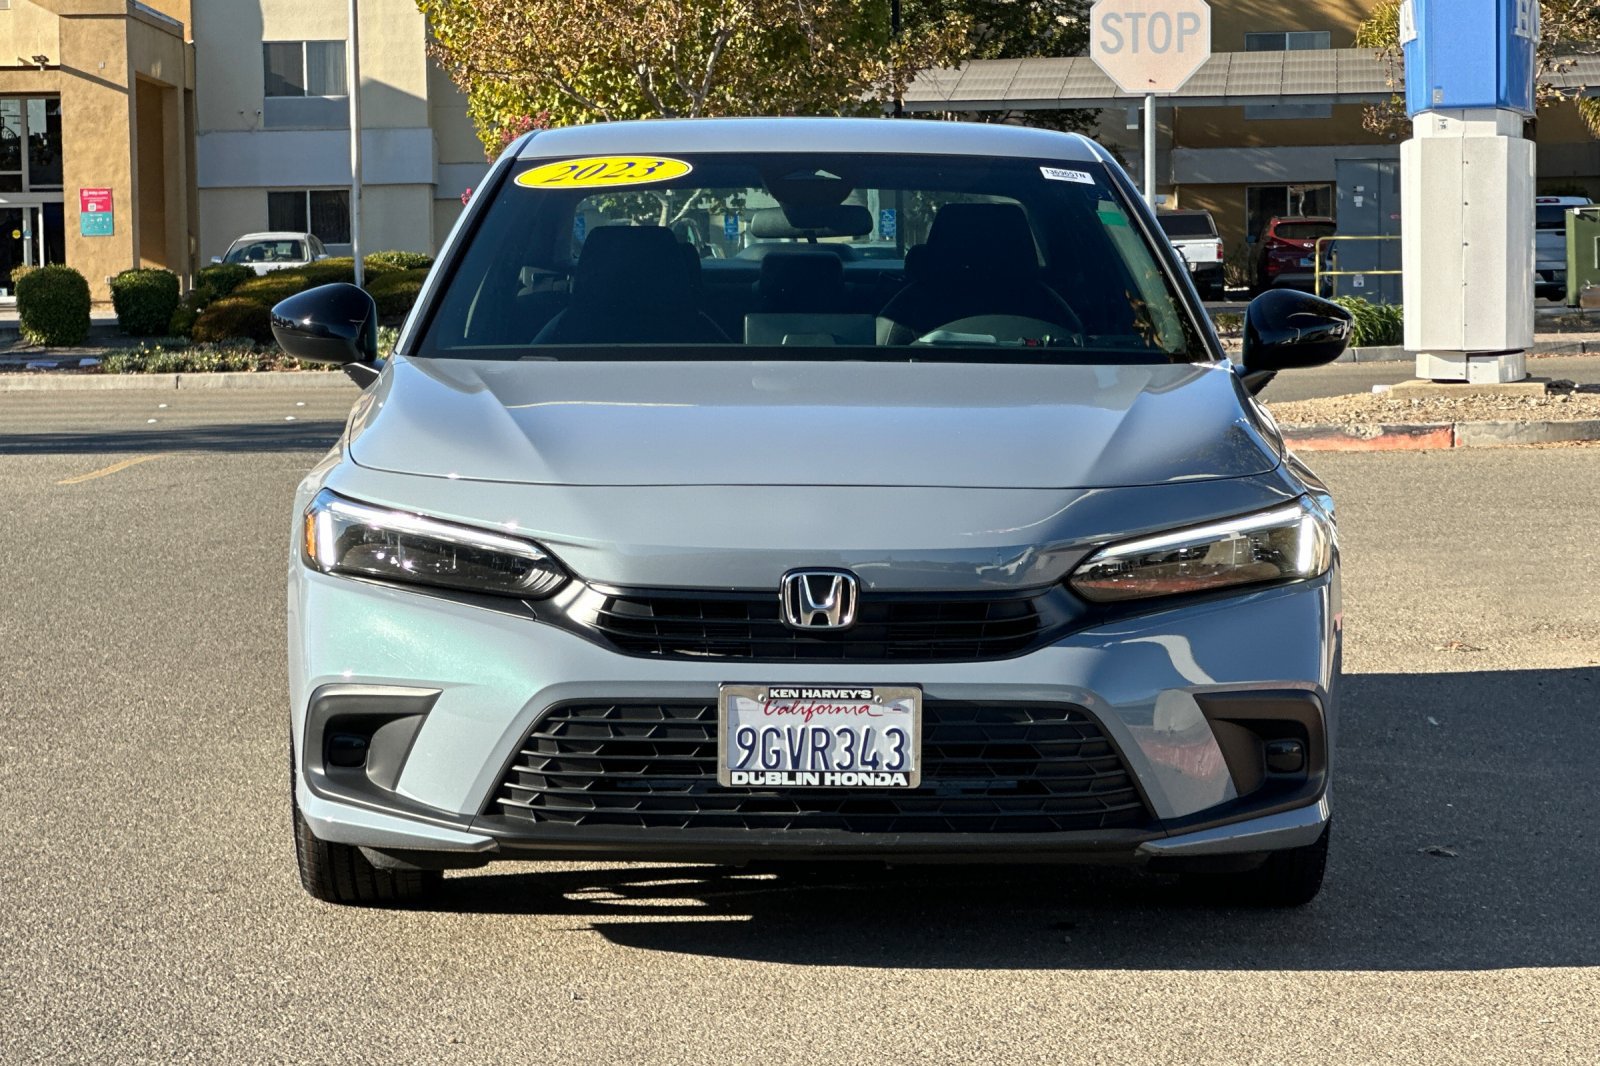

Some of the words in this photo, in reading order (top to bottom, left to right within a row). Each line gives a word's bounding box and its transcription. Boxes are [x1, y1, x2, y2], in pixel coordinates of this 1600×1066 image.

[1100, 11, 1201, 54] STOP
[539, 161, 665, 183] 2023
[769, 689, 800, 699] KEN
[802, 689, 873, 699] HARVEY'S
[763, 700, 883, 723] California
[735, 727, 906, 770] 9GVR343
[731, 771, 822, 786] DUBLIN
[824, 772, 908, 787] HONDA
